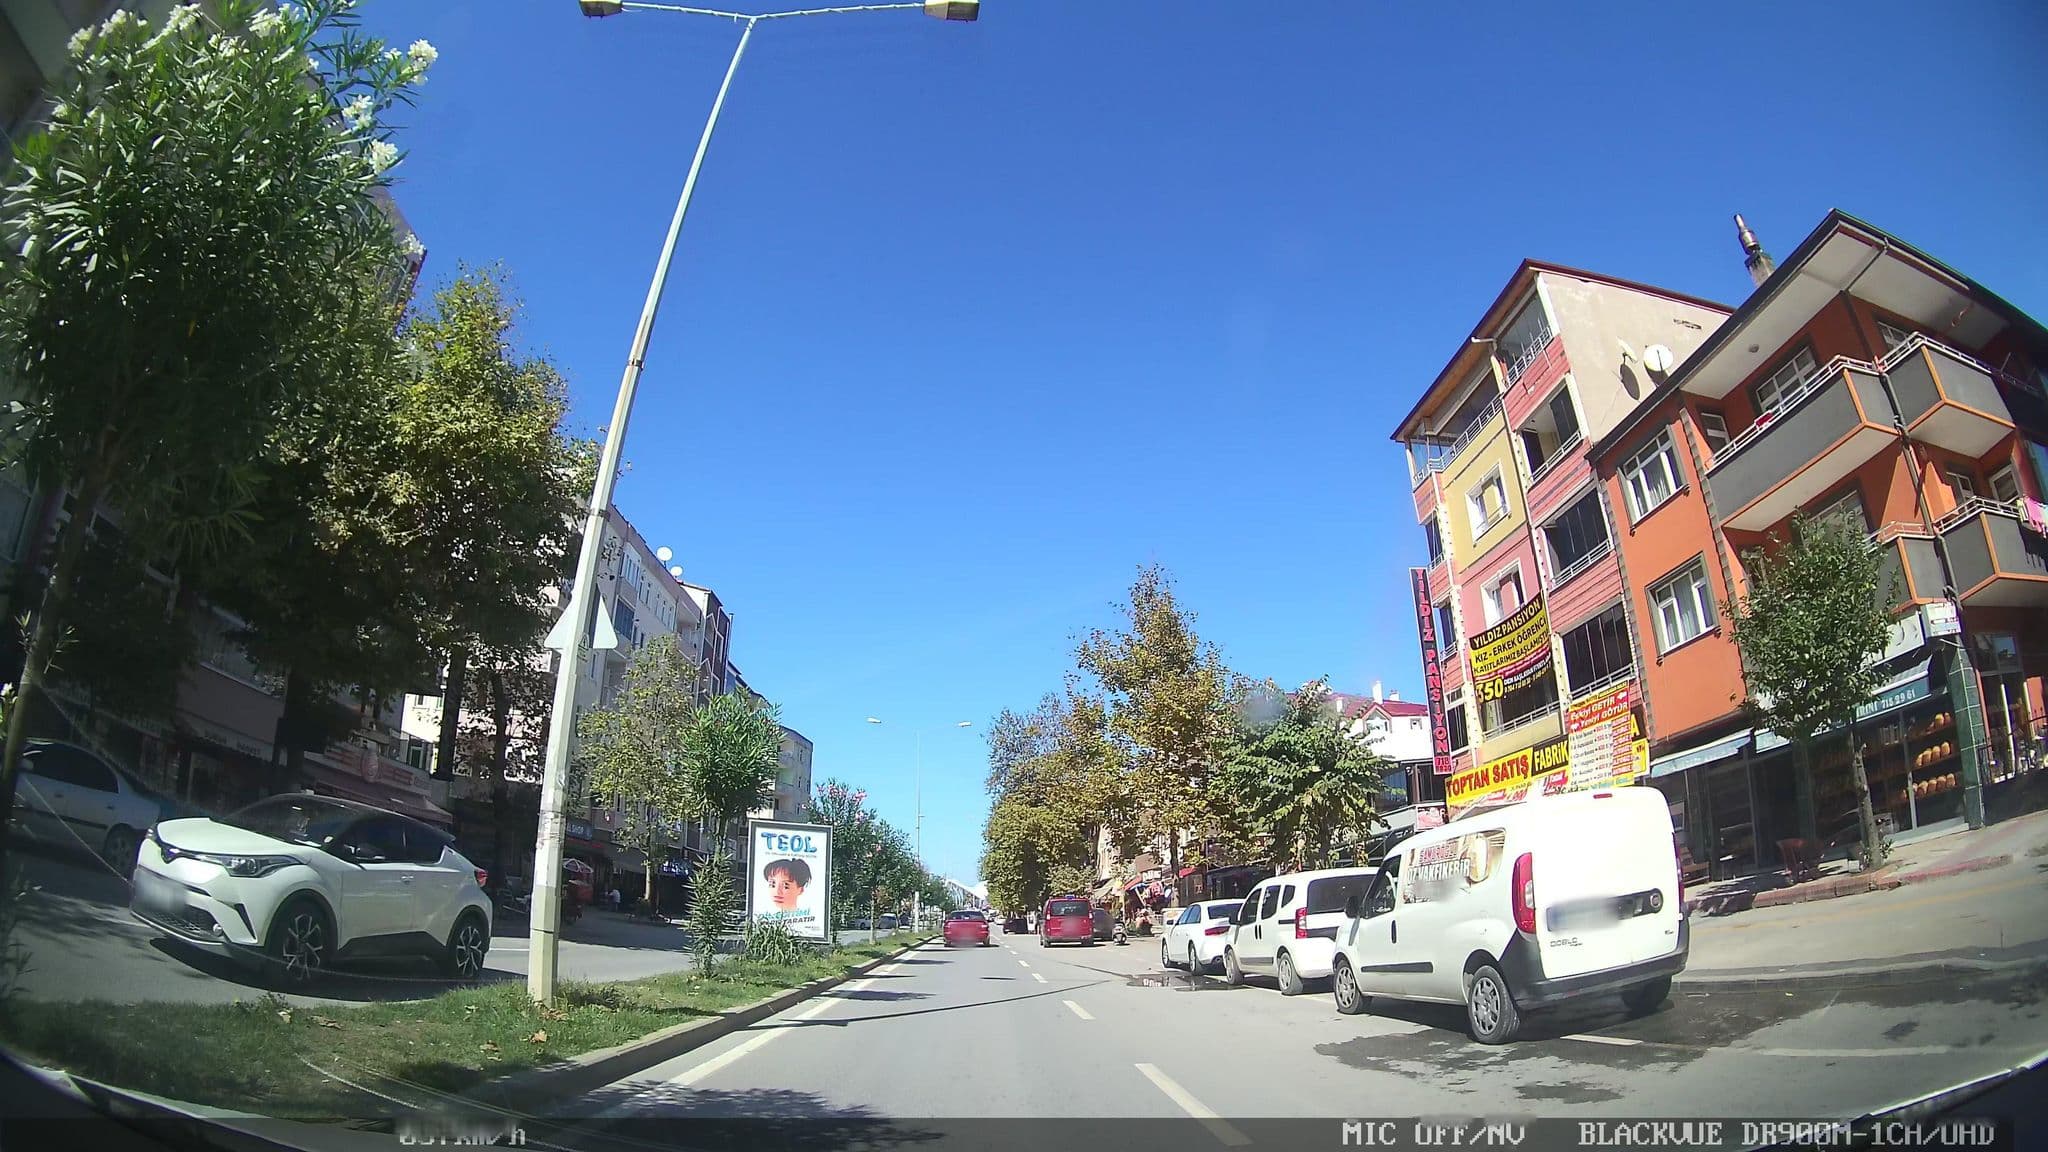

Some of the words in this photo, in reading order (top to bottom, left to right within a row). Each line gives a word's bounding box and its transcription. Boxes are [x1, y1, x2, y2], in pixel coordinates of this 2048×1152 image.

[1474, 628, 1502, 648] YILDIZ
[1502, 599, 1541, 634] PANSİYON
[1416, 569, 1434, 641] YILDIZ
[1426, 649, 1449, 752] PANSİYON
[1475, 652, 1488, 663] KIZ
[1493, 638, 1517, 656] ERKEK
[1476, 678, 1504, 703] 350
[1592, 695, 1615, 712] GETİR
[1601, 702, 1628, 719] GÖTÜR
[1446, 767, 1489, 798] TOPTAN
[1493, 754, 1529, 783] SATIŞ
[761, 831, 818, 853] TEOL
